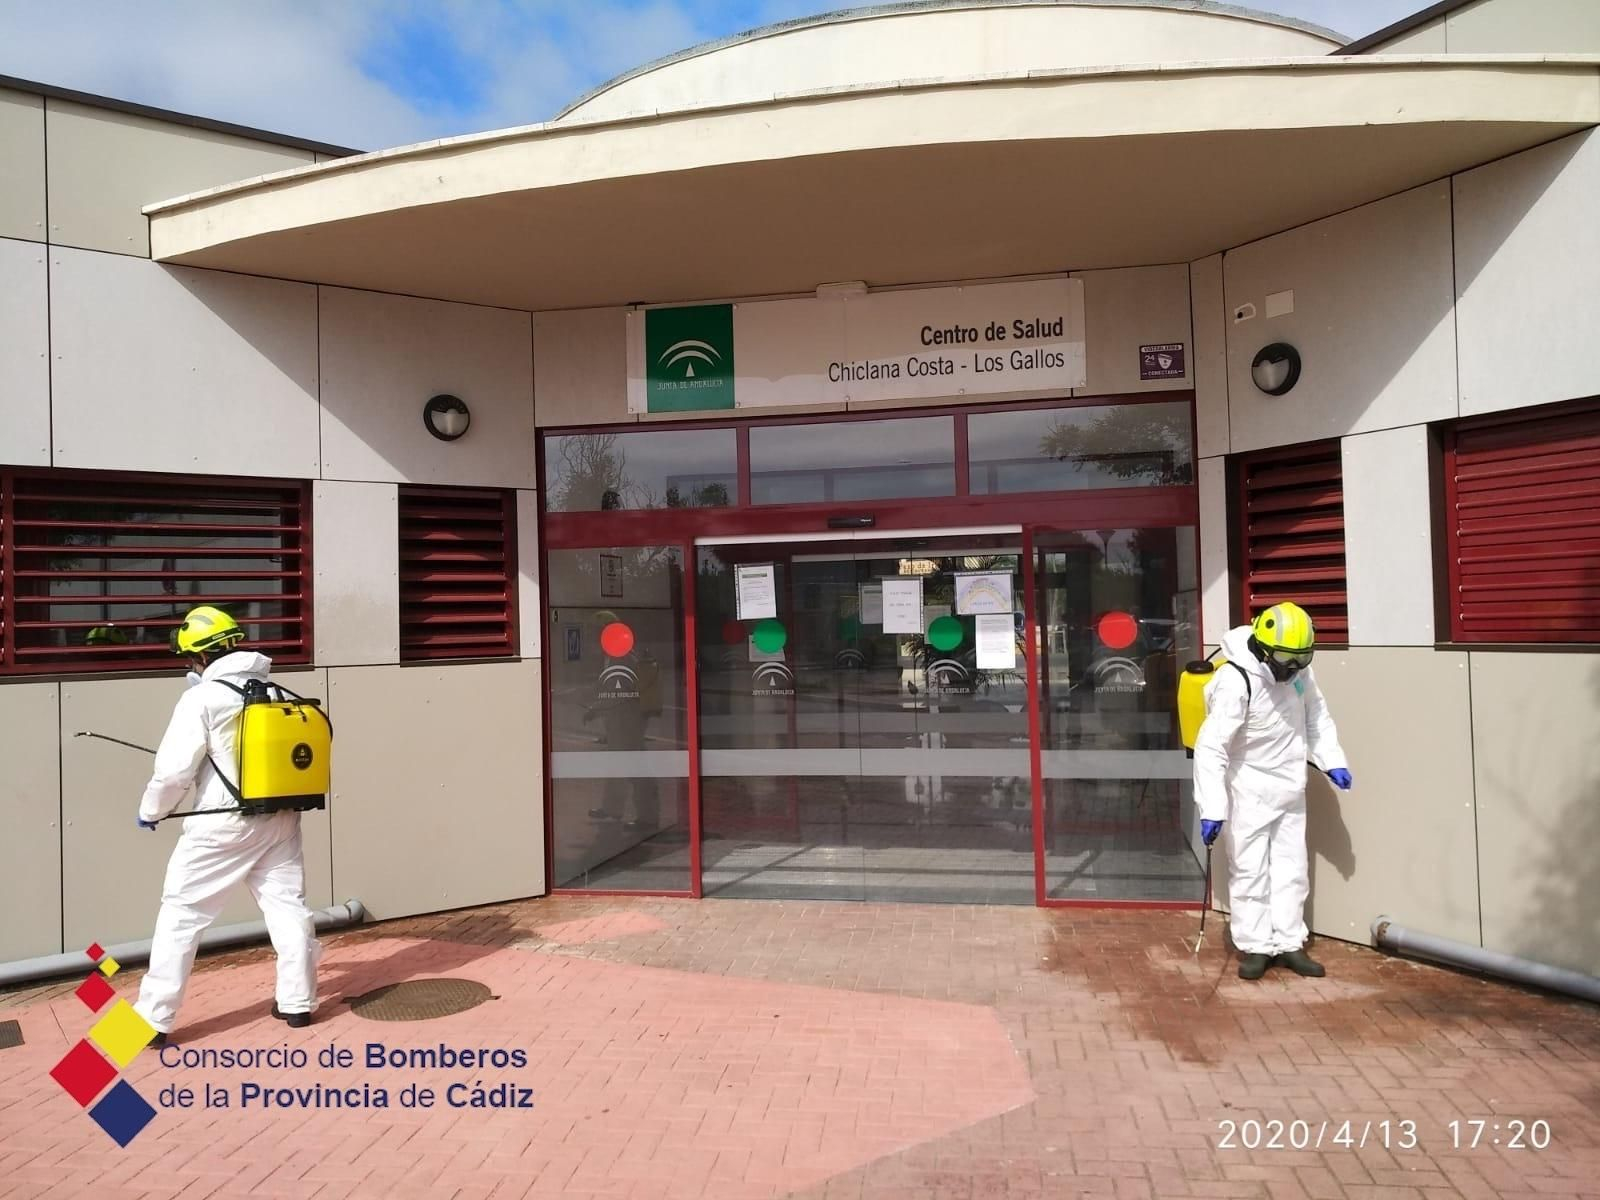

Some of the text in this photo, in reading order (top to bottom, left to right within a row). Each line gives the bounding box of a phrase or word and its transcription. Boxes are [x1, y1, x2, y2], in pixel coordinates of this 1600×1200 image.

[920, 316, 1064, 346] Centro de Salud
[828, 360, 901, 383] Chiclana
[907, 356, 954, 378] Costa
[974, 353, 1004, 373] Los
[1010, 348, 1065, 371] Gallos
[656, 381, 677, 391] JUNTA
[679, 380, 689, 389] DE
